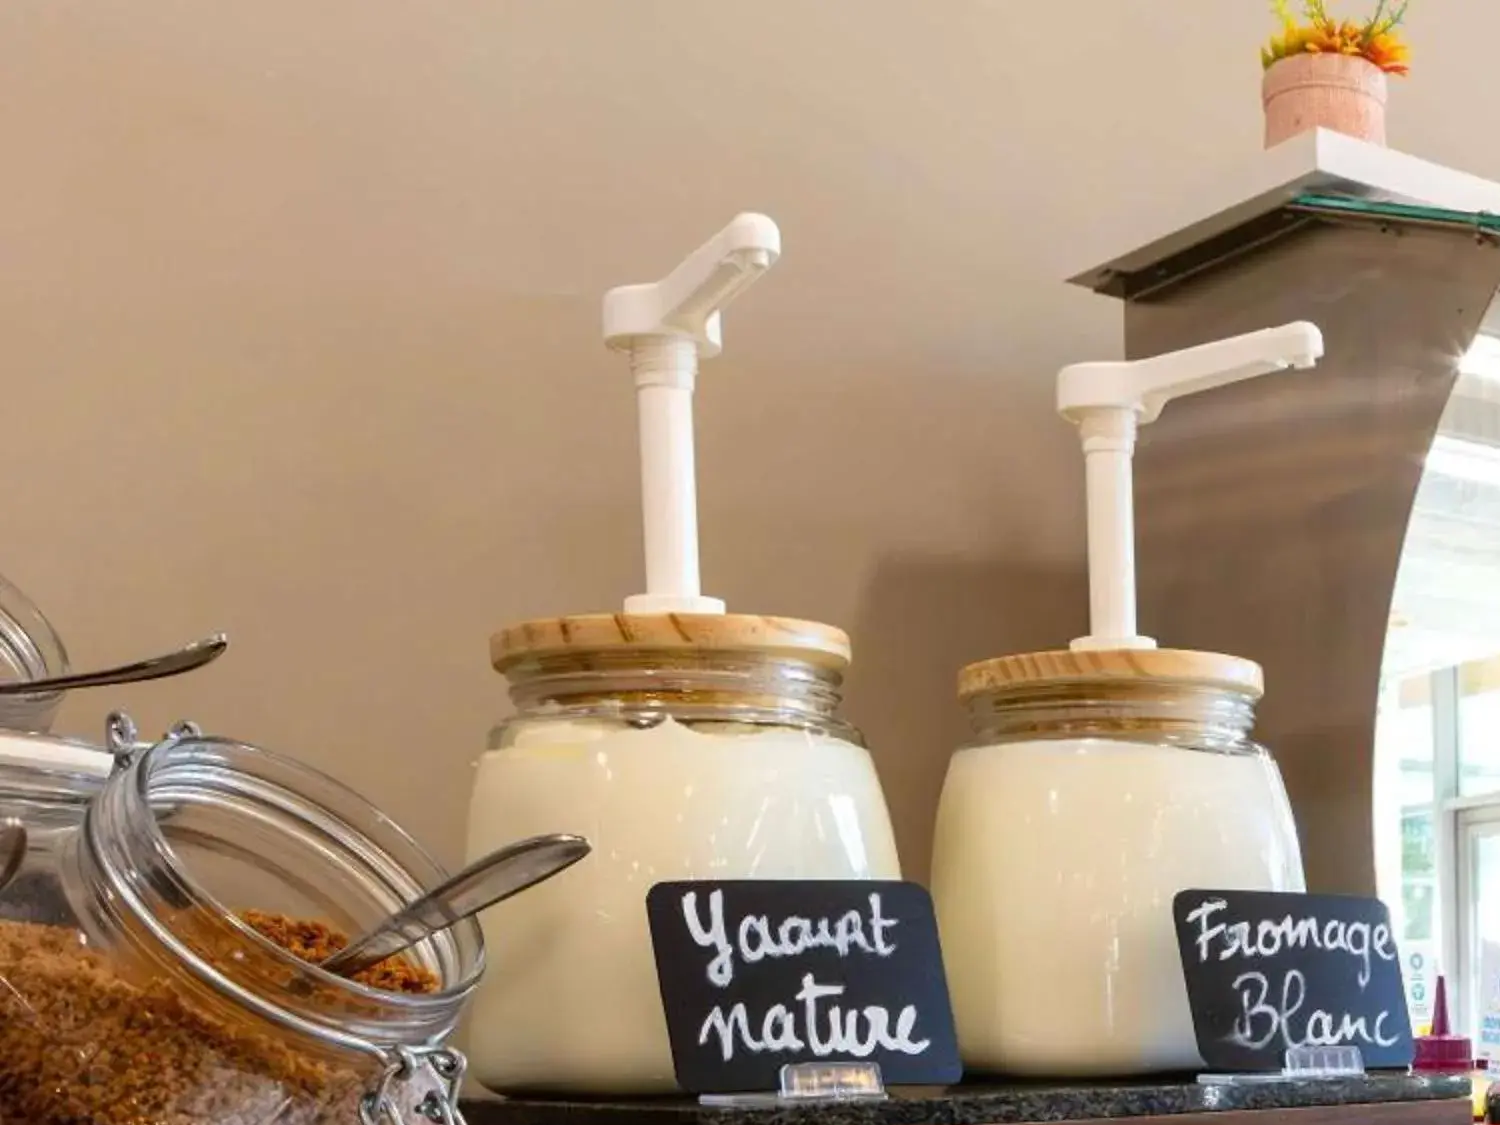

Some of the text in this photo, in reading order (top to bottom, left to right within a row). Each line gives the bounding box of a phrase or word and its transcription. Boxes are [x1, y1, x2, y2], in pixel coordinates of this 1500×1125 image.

[682, 888, 898, 986] Yaourt
[1186, 897, 1396, 988] Fromage
[700, 973, 931, 1062] nature
[1231, 969, 1399, 1049] Blanc
